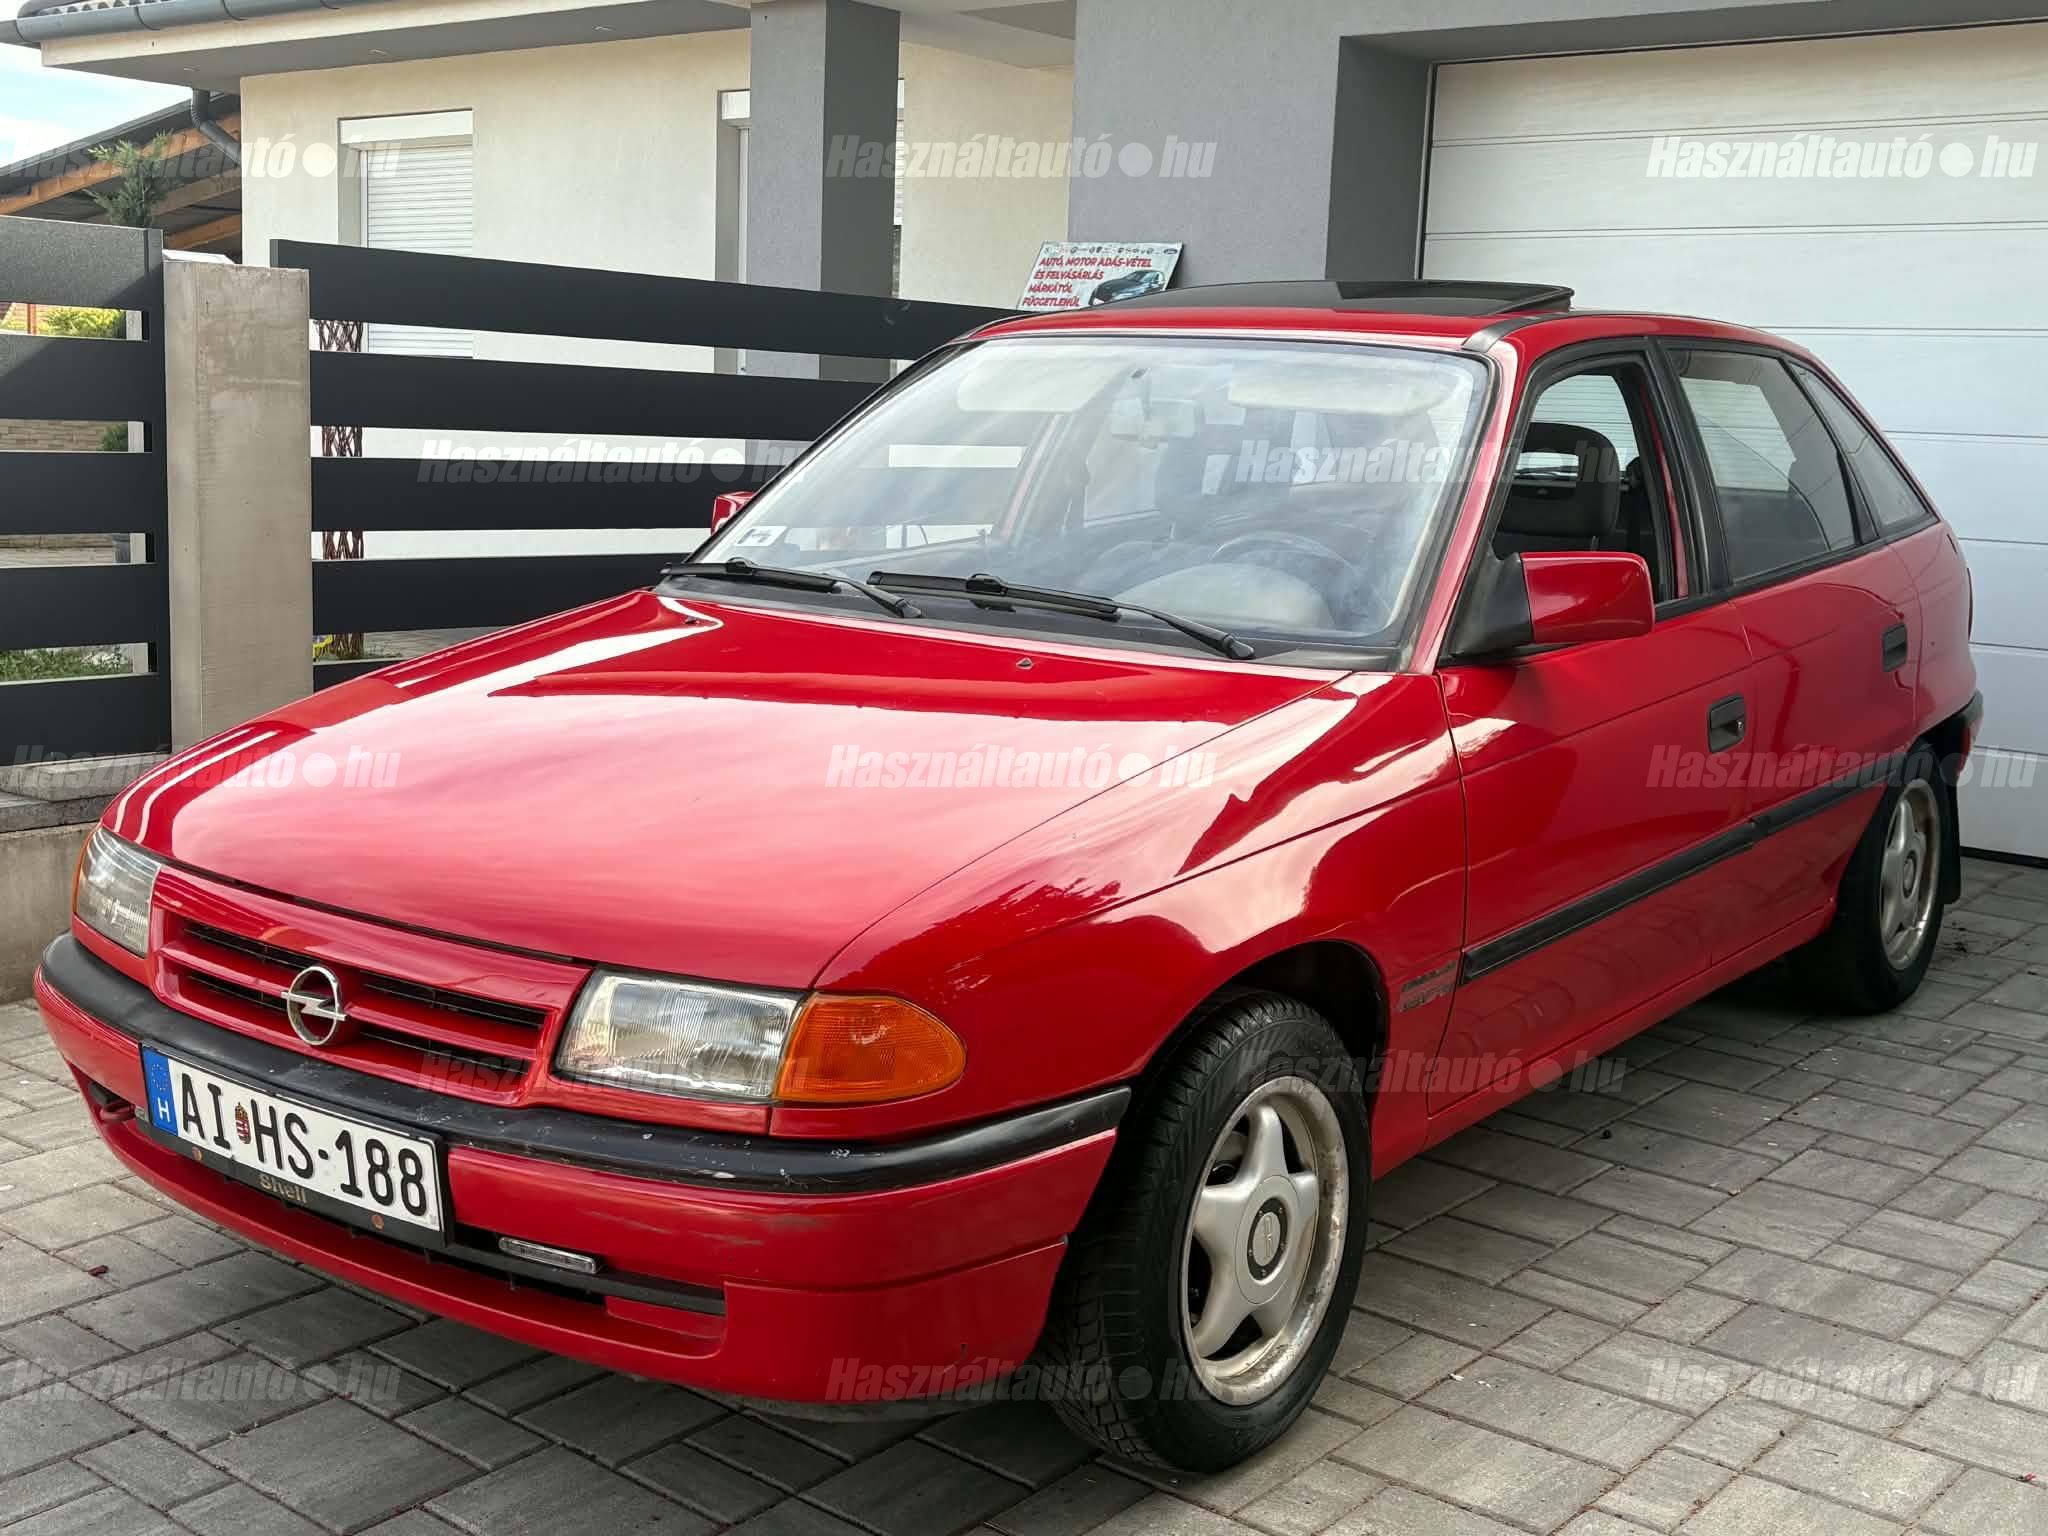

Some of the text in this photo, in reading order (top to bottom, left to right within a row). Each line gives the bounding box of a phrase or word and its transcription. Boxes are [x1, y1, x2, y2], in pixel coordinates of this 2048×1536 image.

[1034, 269, 1104, 280] ÉS FELVÁSÁRLÁS
[1066, 257, 1098, 267] MOTOR
[1099, 255, 1152, 268] ADÁS-VÉTEL
[157, 1096, 171, 1123] H
[181, 1072, 232, 1150] AI
[257, 1174, 307, 1204] Shell
